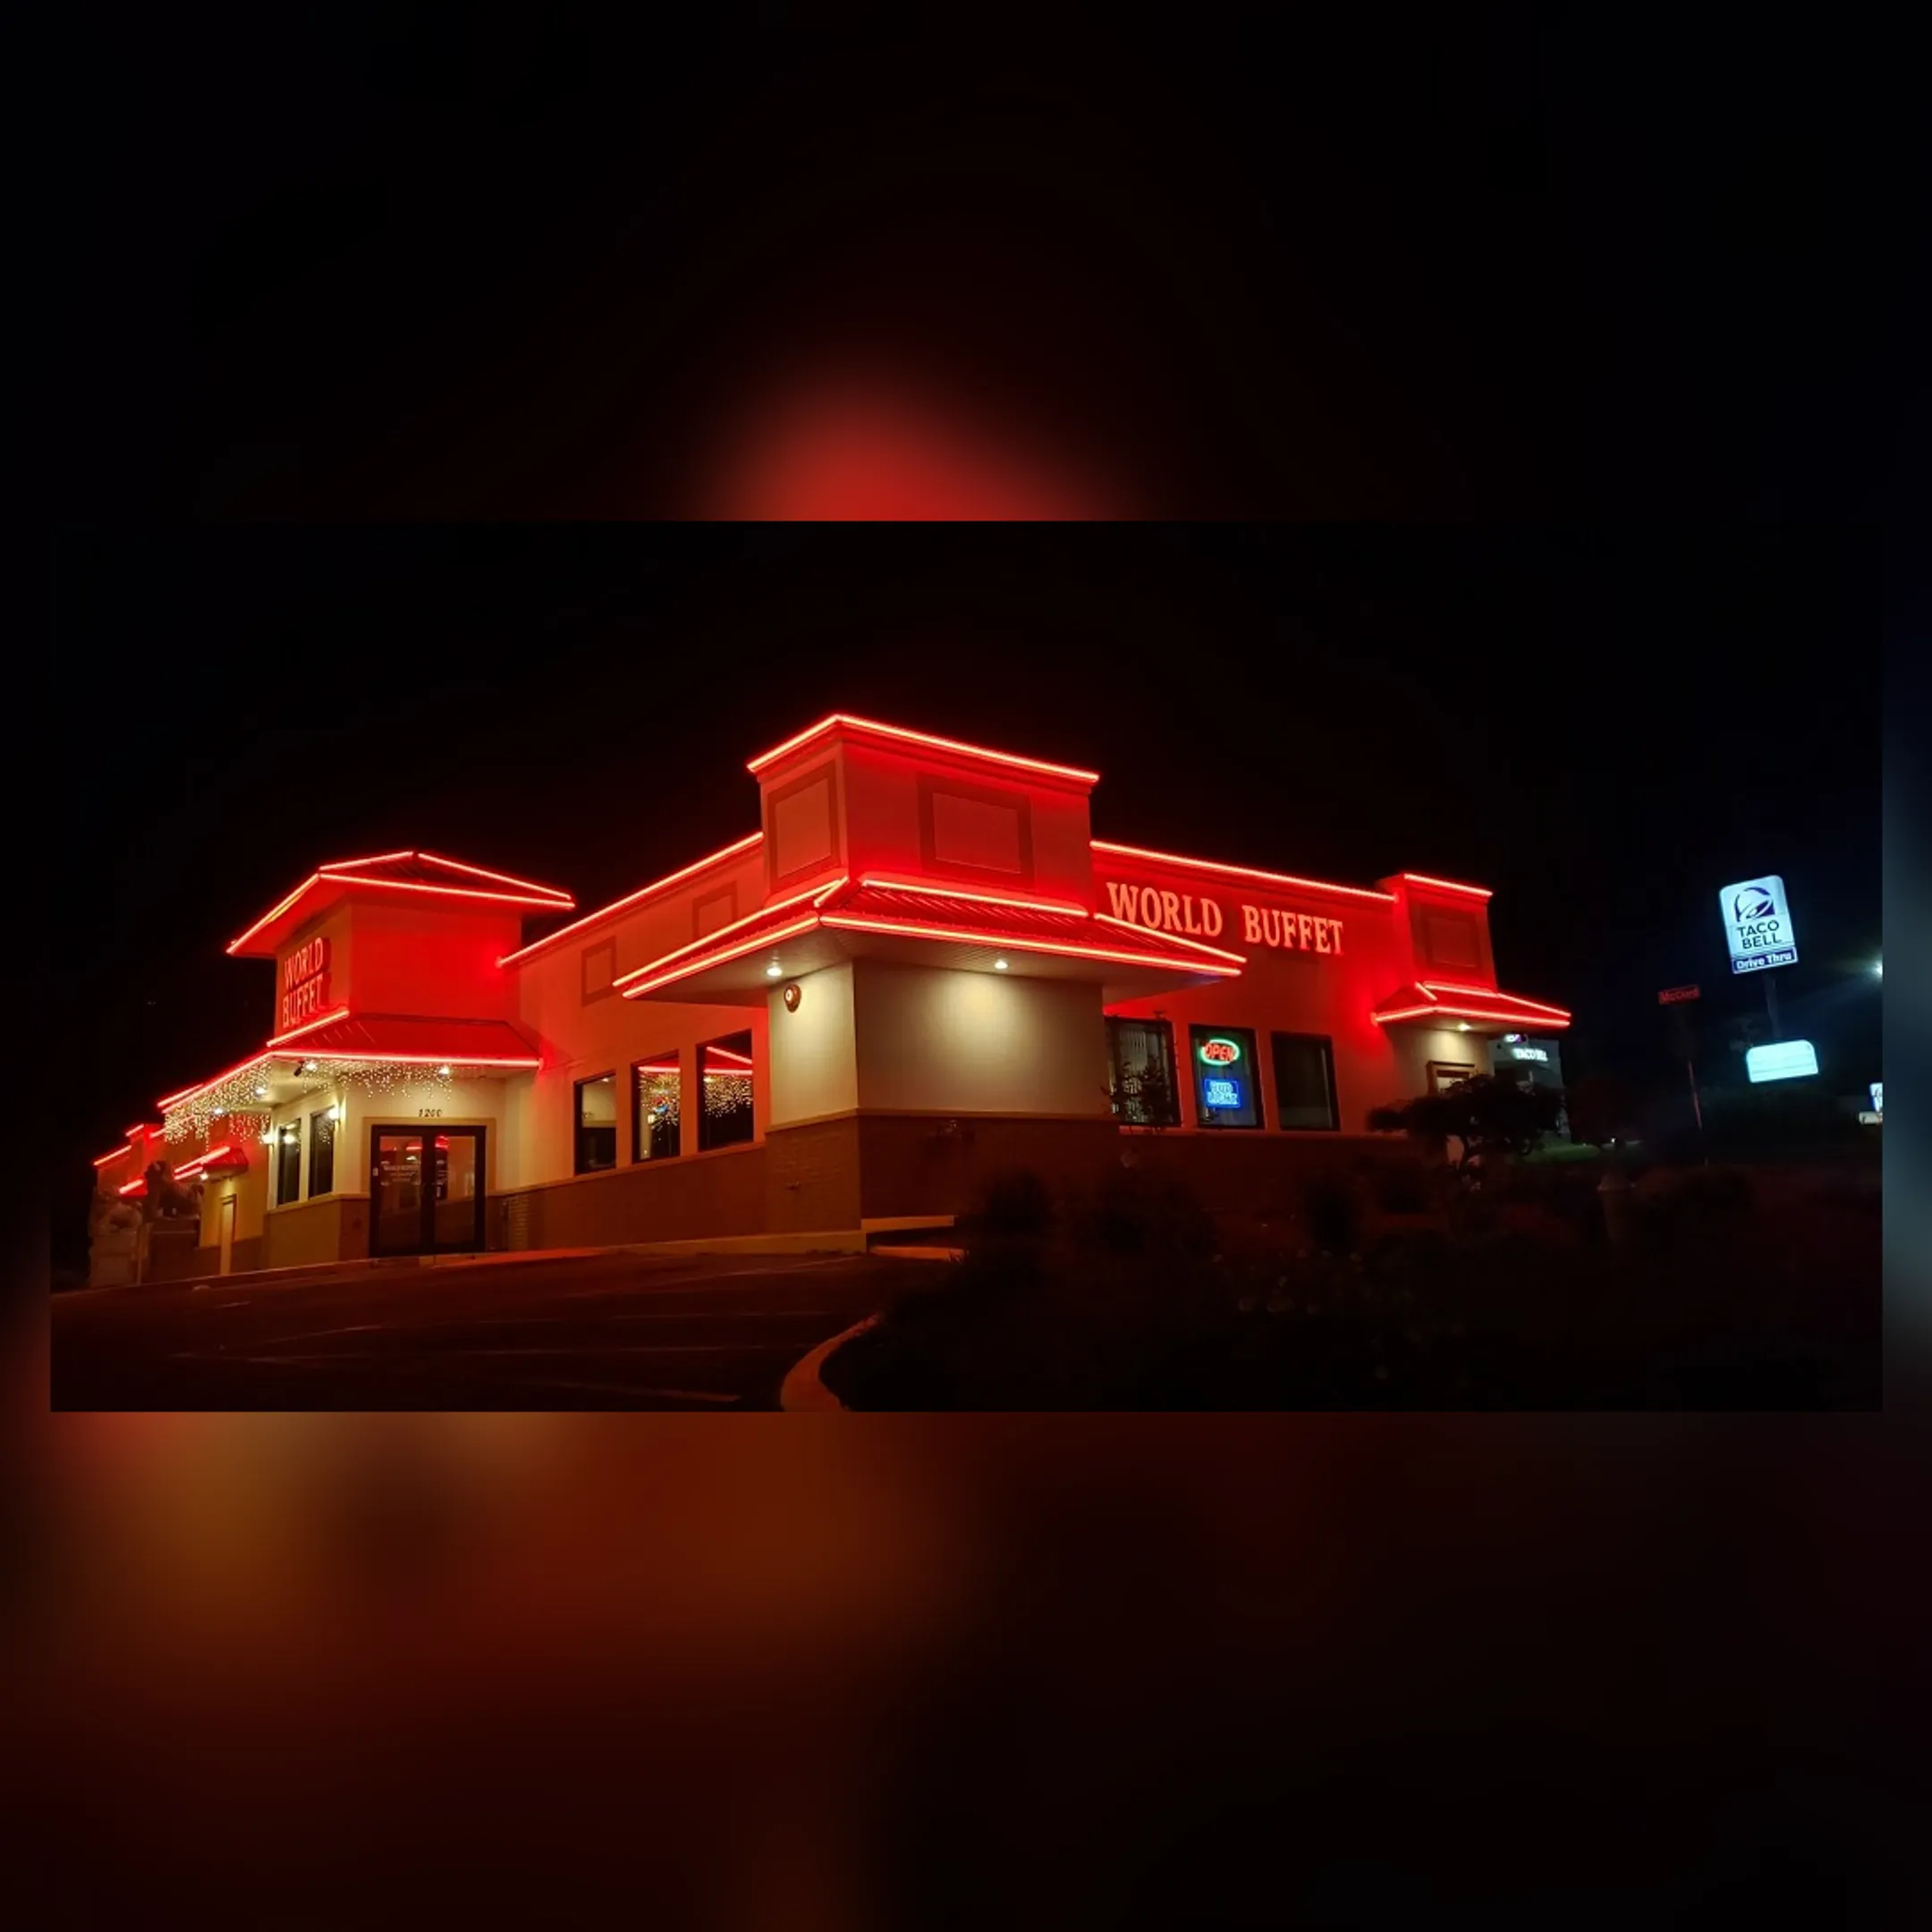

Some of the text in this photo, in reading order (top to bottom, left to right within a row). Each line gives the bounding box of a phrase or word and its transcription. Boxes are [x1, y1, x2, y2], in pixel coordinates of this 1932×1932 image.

[1106, 881, 1343, 954] WORLD BUFFET
[1736, 919, 1780, 937] TACO
[1741, 932, 1783, 949] BELL
[284, 937, 324, 990] WORLD
[1736, 951, 1793, 970] Drive Thru
[283, 972, 324, 1029] BUFFET
[1205, 1042, 1236, 1062] OPEN
